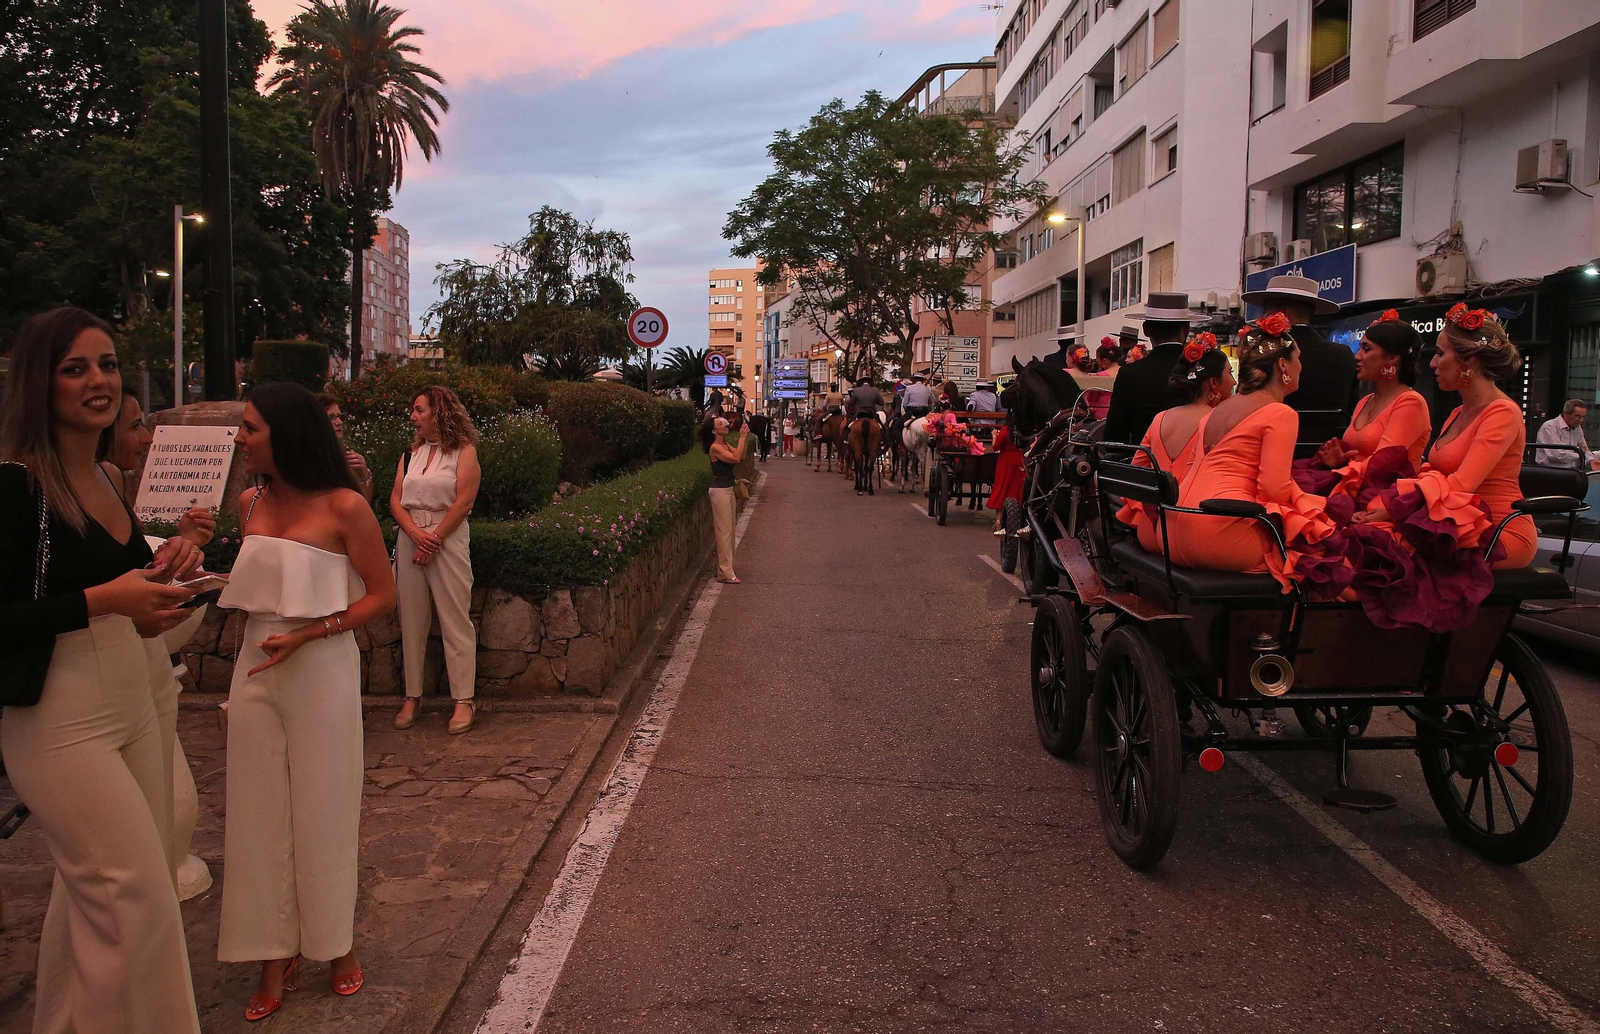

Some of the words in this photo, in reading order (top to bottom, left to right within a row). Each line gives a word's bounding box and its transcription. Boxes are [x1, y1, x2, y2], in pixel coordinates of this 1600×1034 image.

[1318, 277, 1342, 292] ADOS
[637, 320, 659, 333] 20
[1410, 320, 1433, 334] tica
